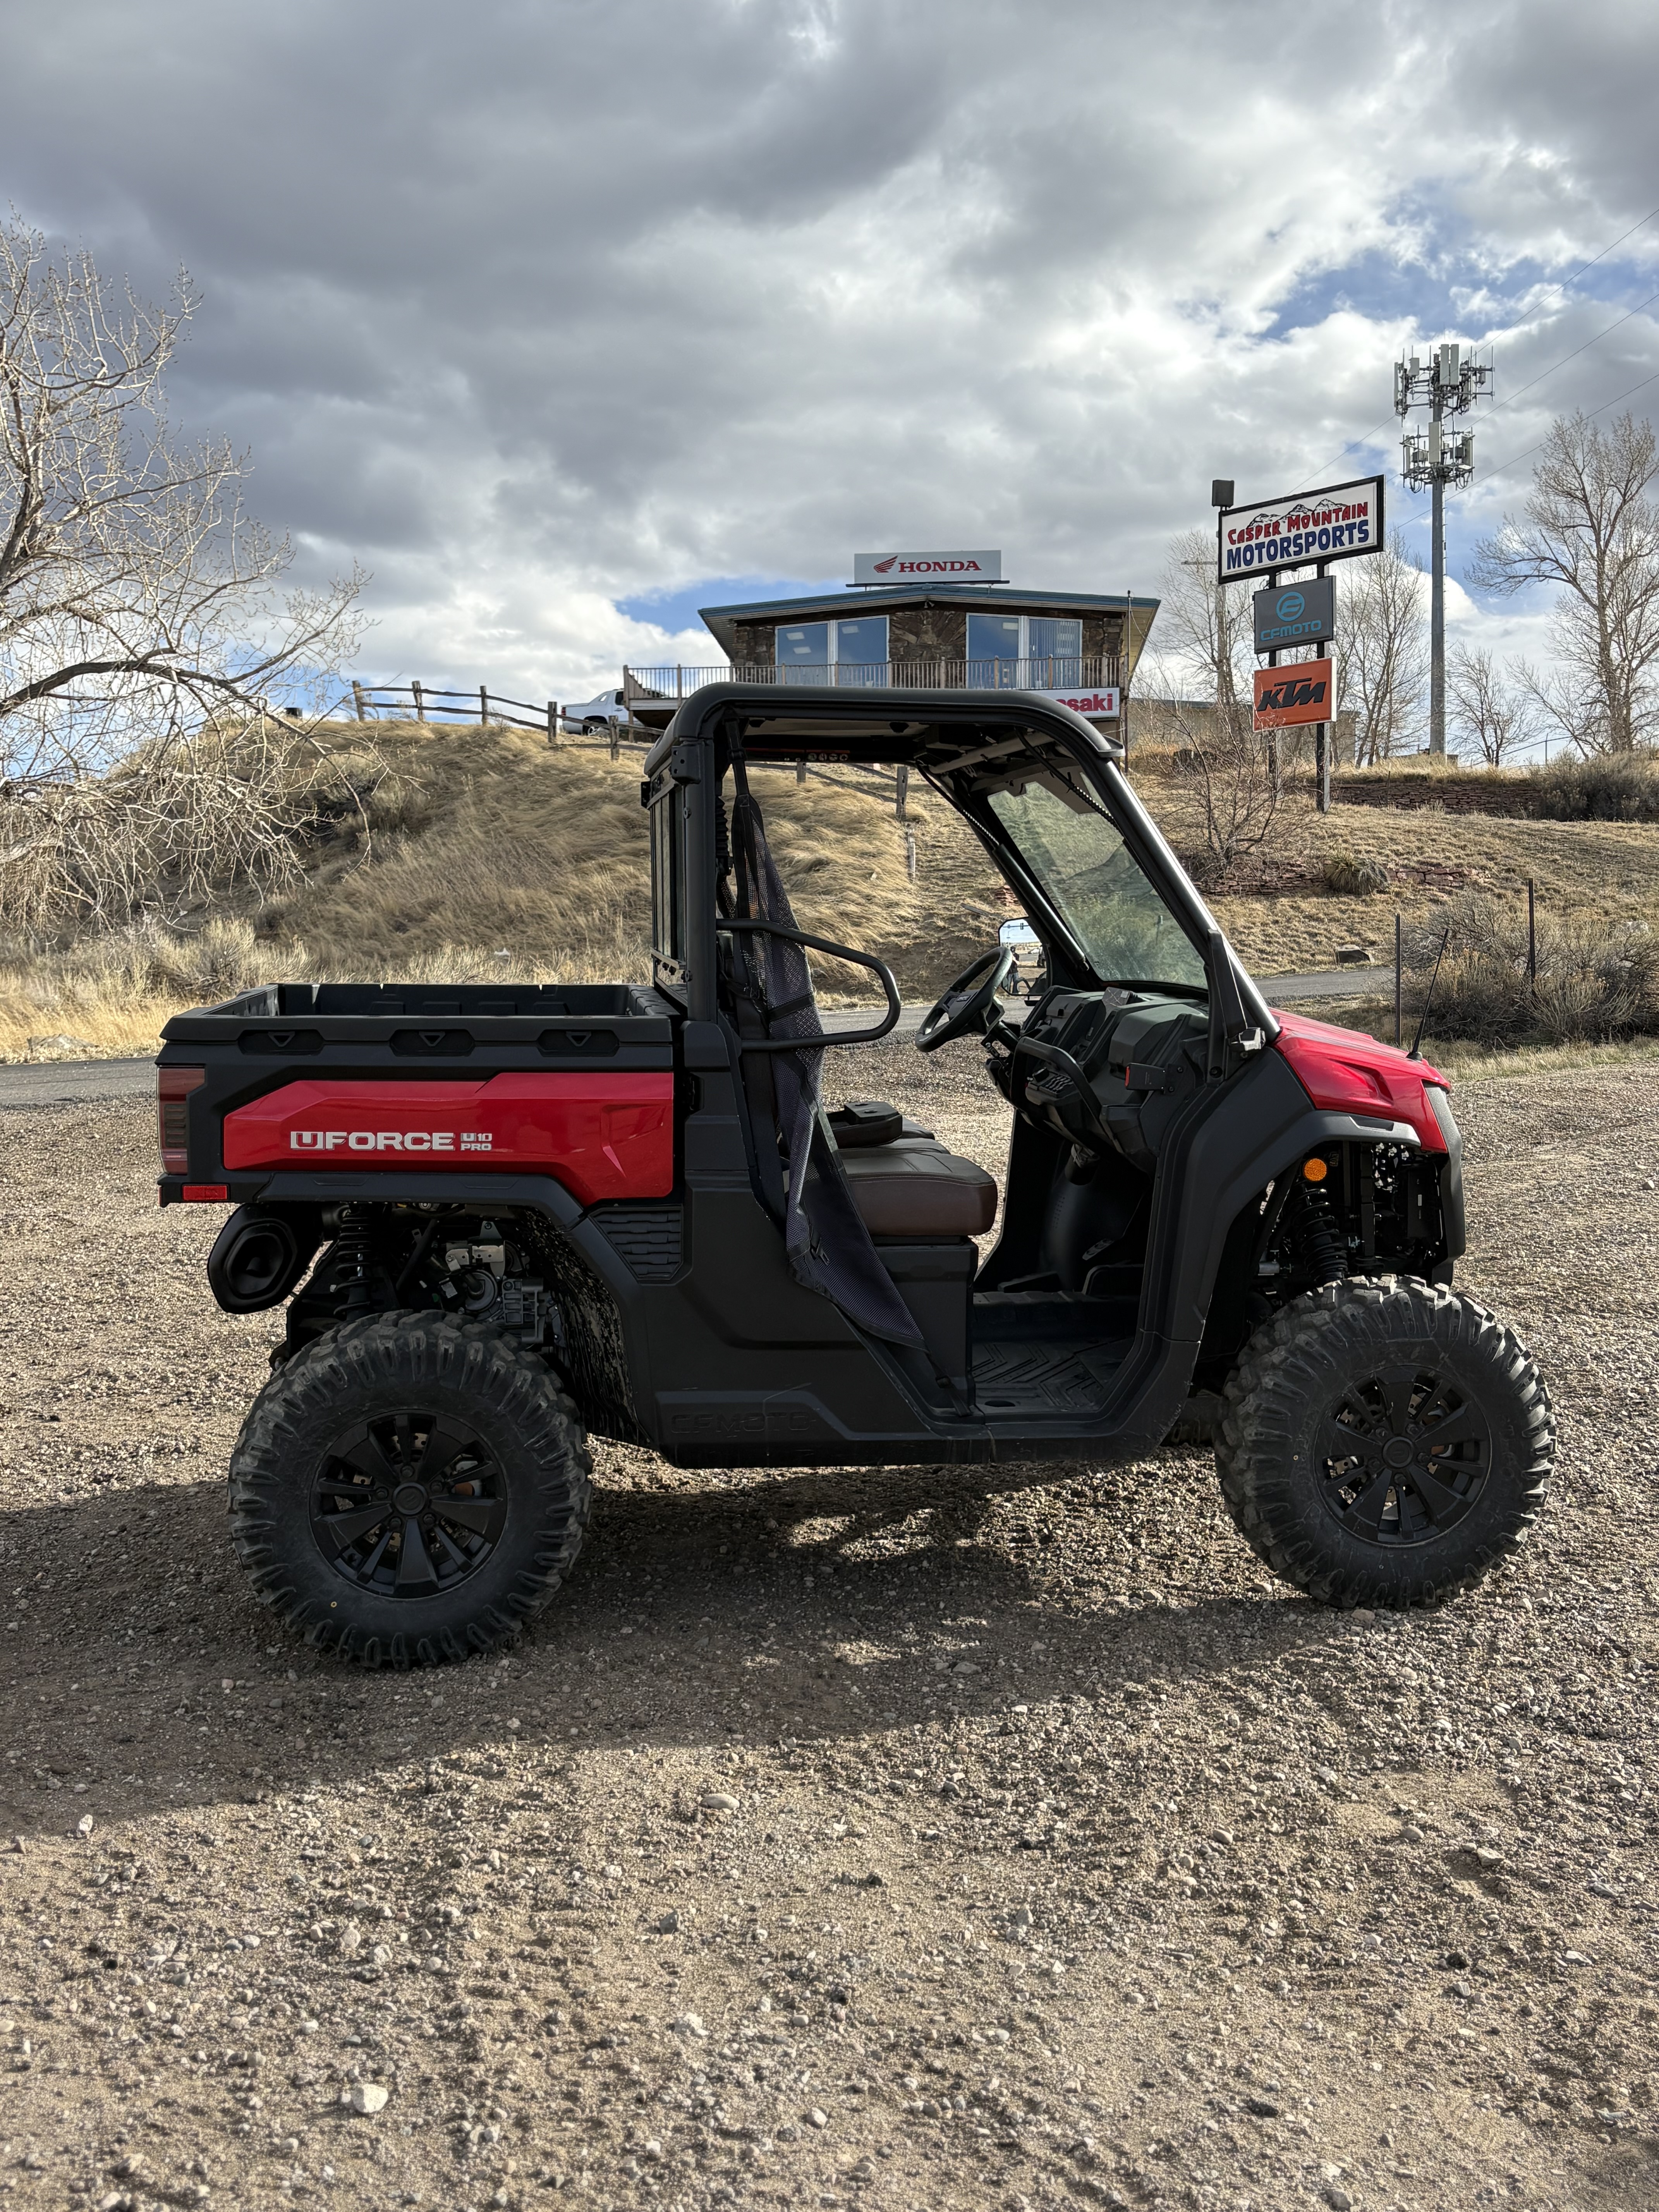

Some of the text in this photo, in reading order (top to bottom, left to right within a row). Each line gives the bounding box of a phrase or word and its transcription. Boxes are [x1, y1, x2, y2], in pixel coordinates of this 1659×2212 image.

[1228, 502, 1368, 545] CASPER MOUNTAIN
[1226, 519, 1369, 570] MOTORSPORTS
[898, 560, 982, 572] HONDA
[1261, 620, 1322, 641] CFMOTO
[1257, 677, 1326, 711] KTM
[290, 1131, 492, 1151] UFORCE U10
[671, 1412, 810, 1434] CFMOTO
